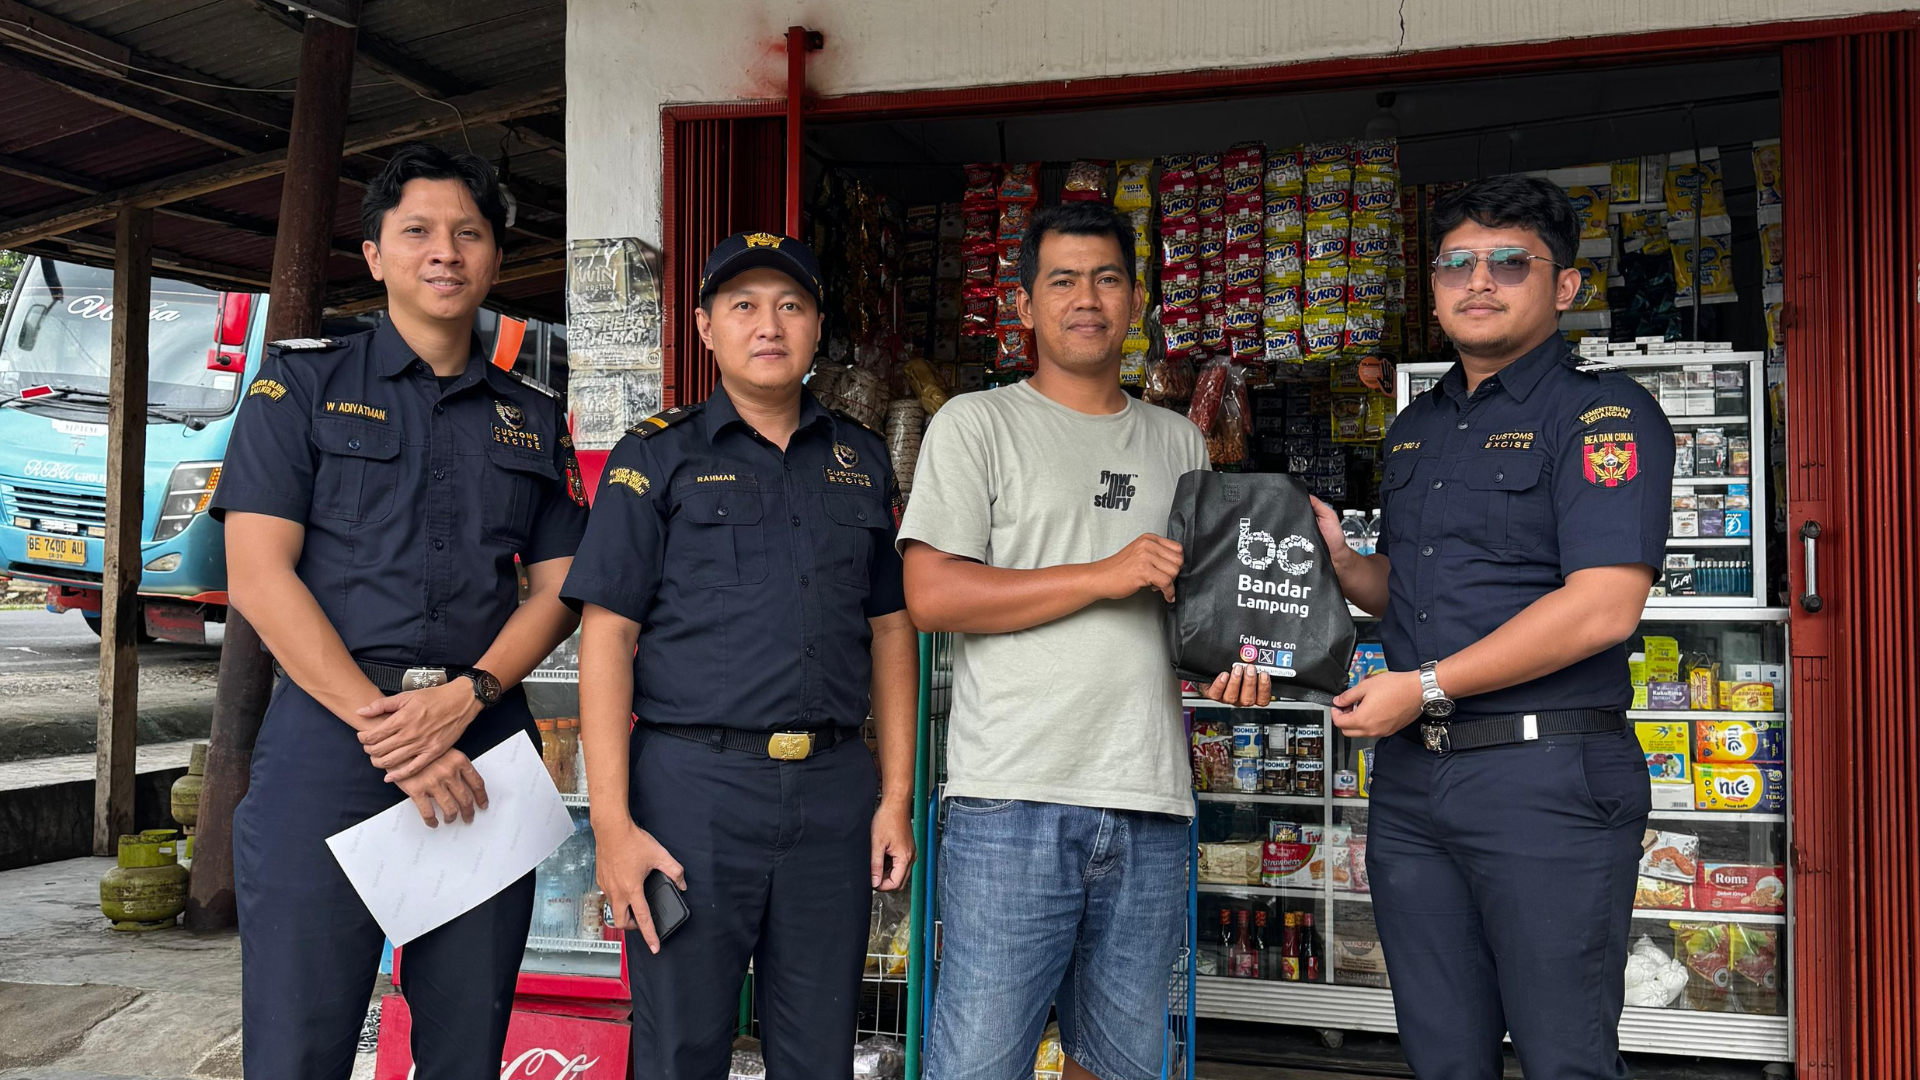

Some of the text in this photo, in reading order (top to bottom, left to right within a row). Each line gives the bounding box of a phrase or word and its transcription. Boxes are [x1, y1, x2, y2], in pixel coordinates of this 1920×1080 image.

[1266, 154, 1298, 169] SUKRO
[1312, 147, 1348, 161] SUKRO
[1360, 147, 1394, 163] SUKRO
[1227, 176, 1260, 193] SUKRO
[1163, 197, 1195, 216] SUKRO
[1265, 198, 1297, 215] SUKRO
[1310, 192, 1345, 209] SUKRO
[1358, 194, 1393, 210] SUKRO
[1265, 244, 1297, 261] SUKRO
[1356, 240, 1389, 256] SUKRO
[1227, 268, 1260, 285] SUKRO
[586, 283, 612, 292] KRETEK
[1308, 287, 1343, 304] SUKRO
[1354, 285, 1386, 301] SUKRO
[1165, 288, 1198, 306] SUKRO
[1264, 288, 1297, 305] SUKRO
[602, 315, 656, 331] HEBAT
[1226, 312, 1260, 326] SUKRO
[1351, 329, 1382, 343] SUKRO
[326, 401, 386, 421] W ADIYATMAN
[1579, 405, 1631, 422] KEMENTERIAN
[1584, 411, 1629, 425] KEUANGAN
[494, 426, 539, 441] CUSTOMS
[1489, 432, 1534, 441] CUSTOMS
[1584, 432, 1634, 445] BEA DAN CUKAI
[494, 434, 541, 450] EXCISE
[1484, 441, 1531, 449] EXCISE
[697, 474, 737, 483] RAHMAN
[826, 468, 870, 481] CUSTOMS
[829, 475, 872, 487] EXCISE
[28, 538, 83, 555] BE 7400 AU
[1237, 517, 1315, 576] bc
[1238, 574, 1311, 599] Bandar
[1237, 594, 1309, 618] Lampung
[1239, 634, 1269, 647] follow
[1270, 640, 1282, 649] us
[1233, 726, 1259, 734] NDOMILK
[1298, 727, 1324, 736] NDOMILK
[1264, 761, 1290, 769] NDOMILK
[1297, 762, 1323, 770] NDOMILK
[1263, 858, 1302, 867] Strawberry
[1715, 873, 1748, 884] Roma
